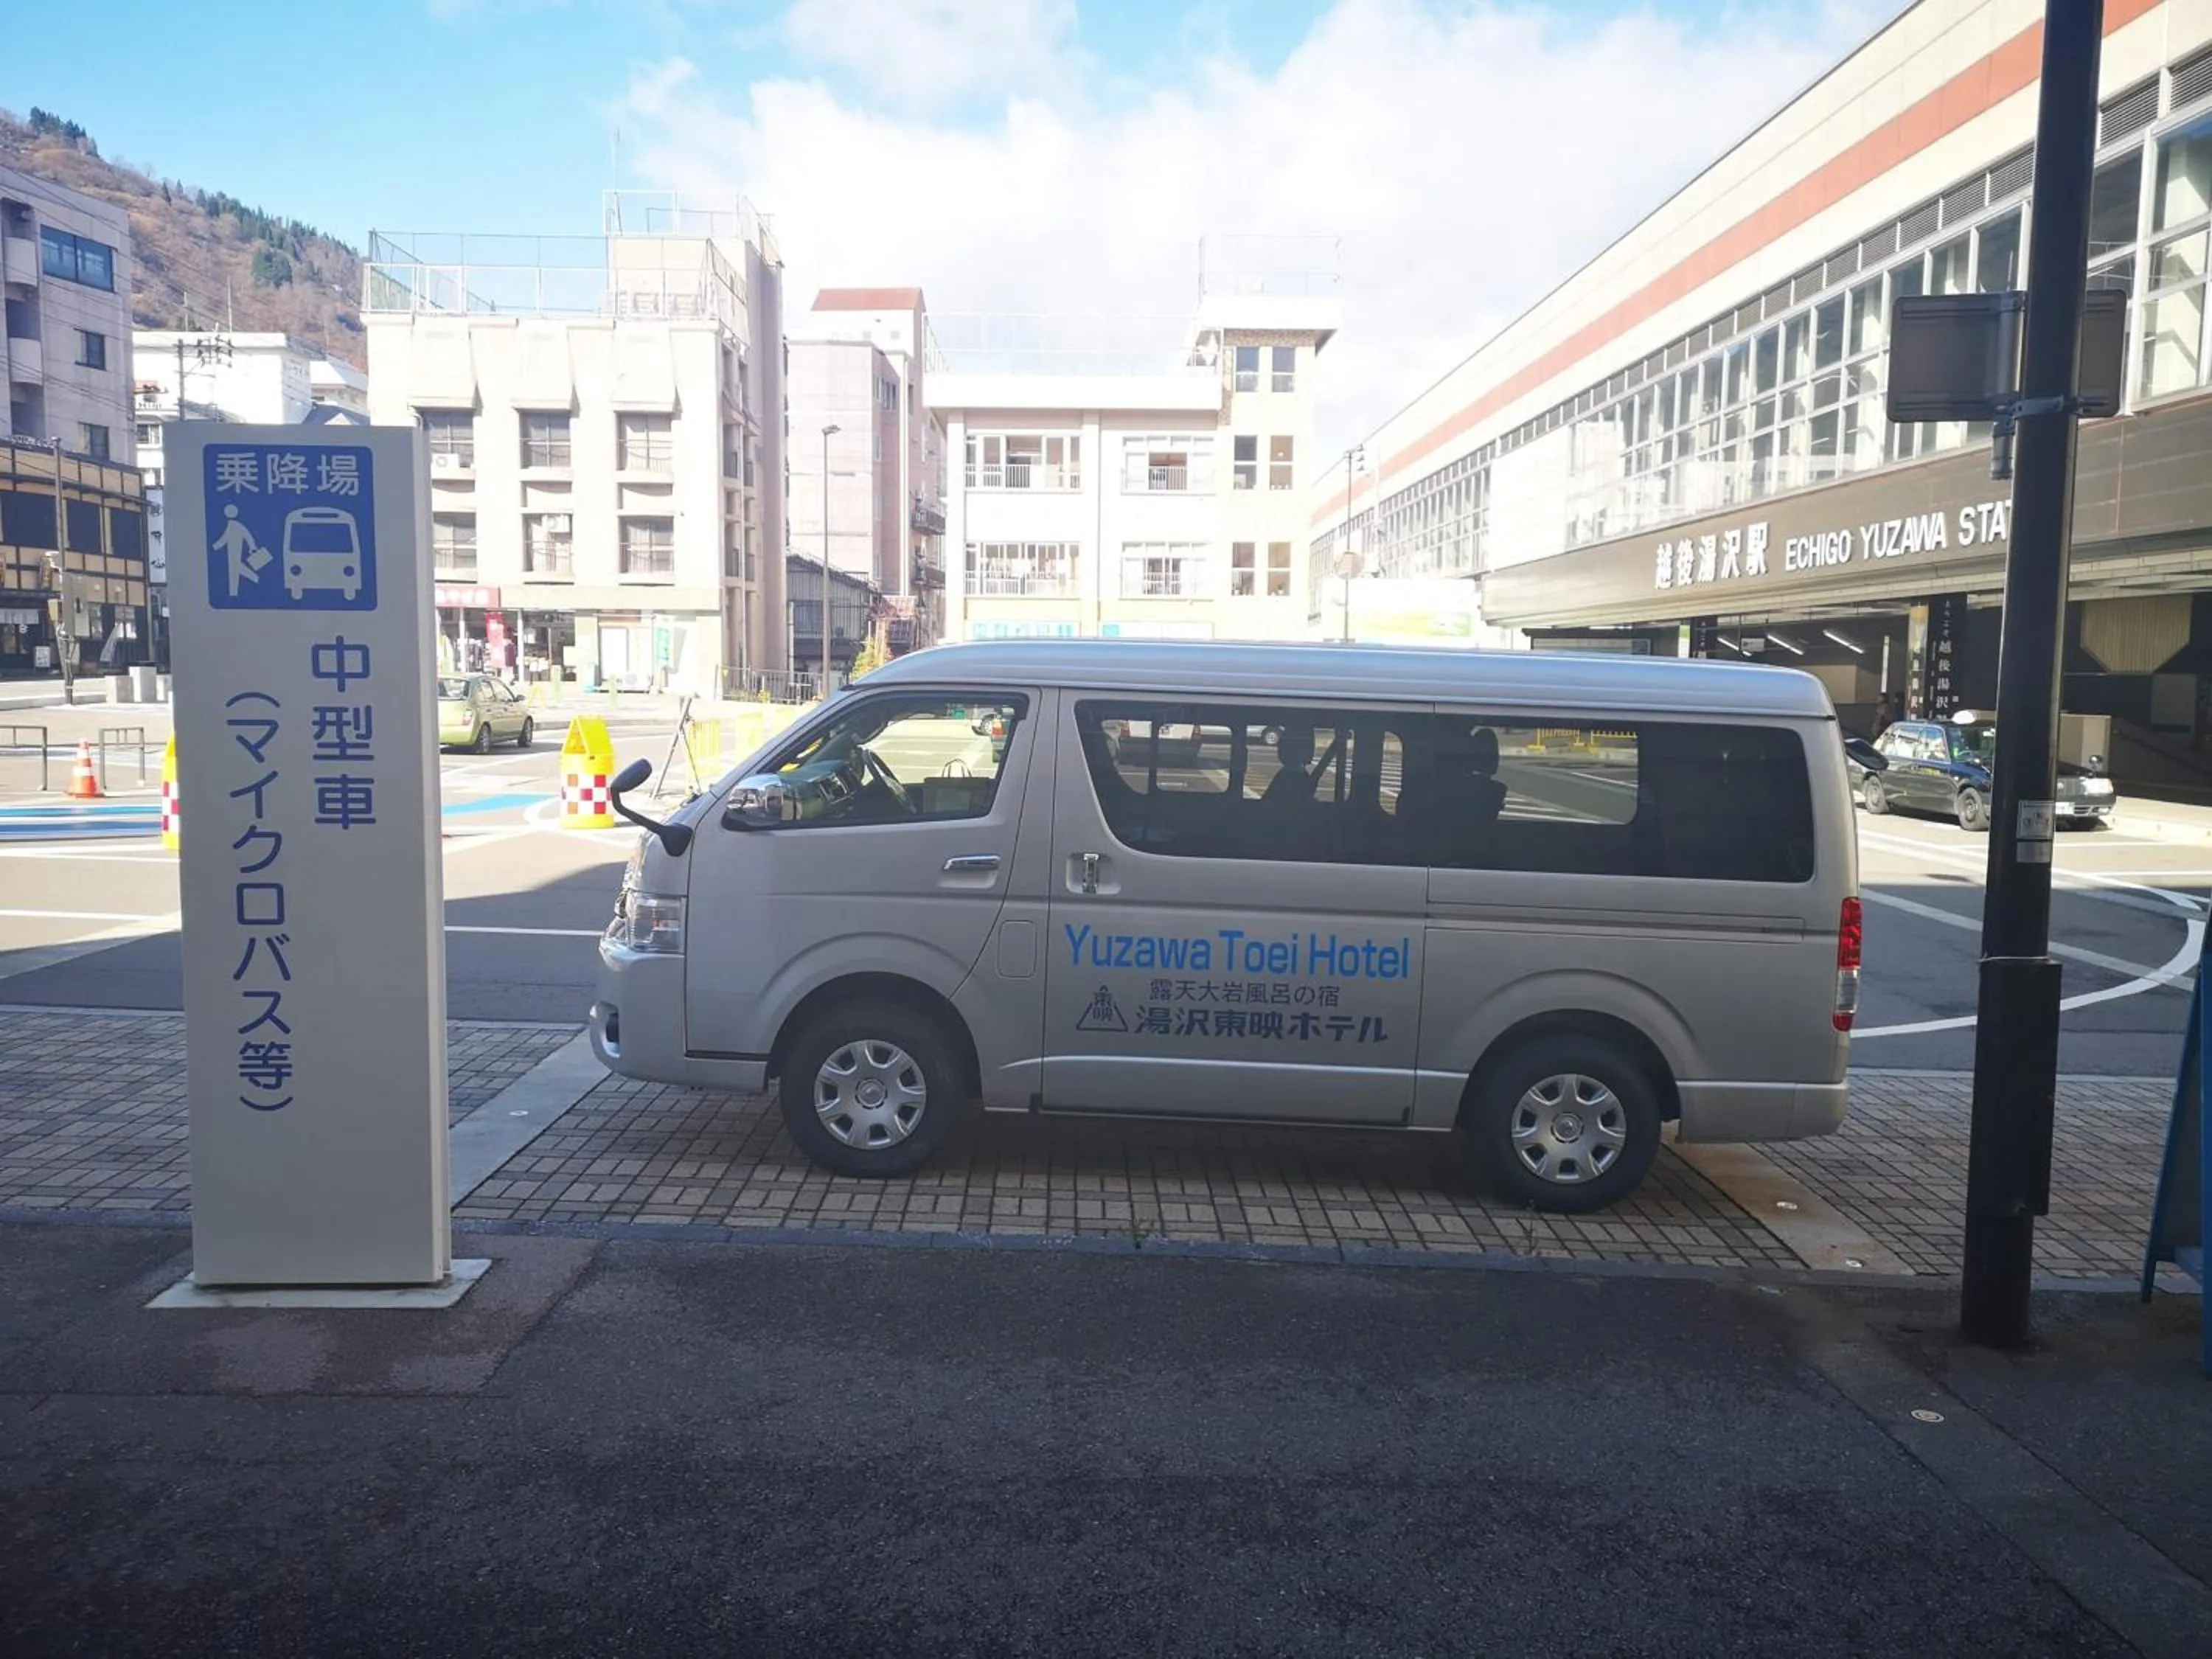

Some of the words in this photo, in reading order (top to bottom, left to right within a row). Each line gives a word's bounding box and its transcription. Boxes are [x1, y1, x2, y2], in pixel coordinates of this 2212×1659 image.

[215, 451, 360, 495] 乗降場
[1655, 521, 1770, 590] 越後湯沢駅
[1784, 529, 1852, 572] ECHIGO
[1860, 511, 1948, 559] YUZAWA
[311, 635, 377, 830] 中型車
[1064, 922, 1211, 972] Yuzawa
[1218, 929, 1298, 975] Toei
[1309, 933, 1409, 980] Hotel
[1150, 978, 1340, 1007] 露天大岩風呂の宿
[1135, 1007, 1388, 1044] 湯沢東映ホテル
